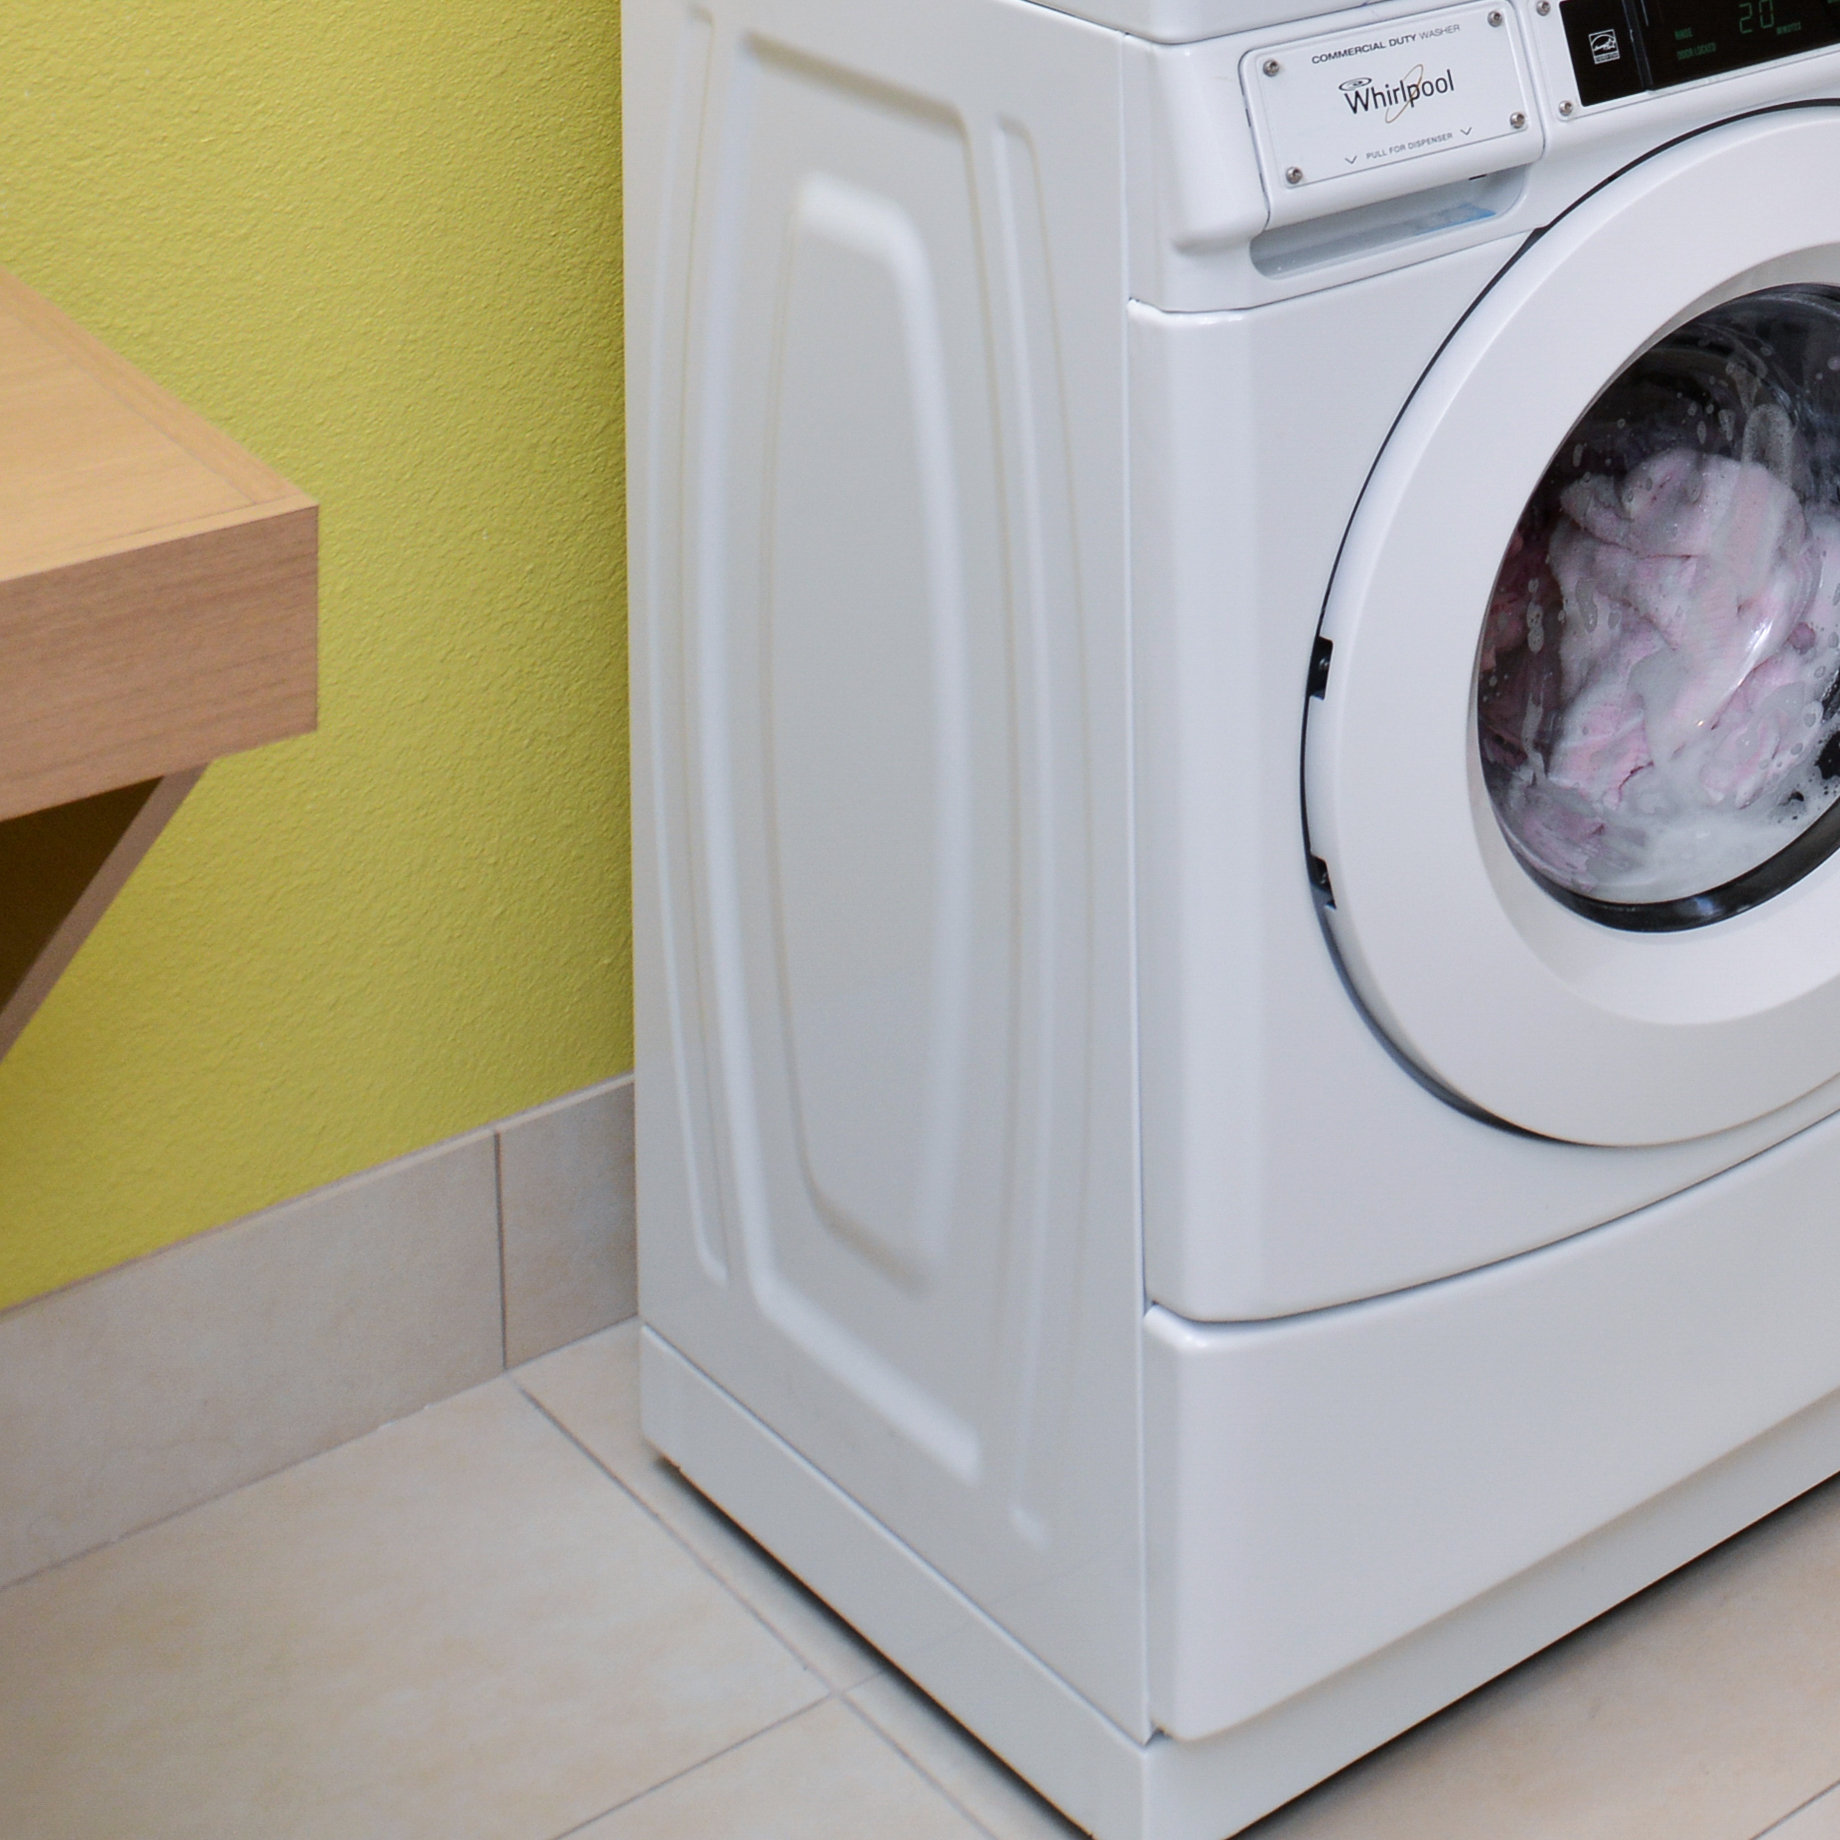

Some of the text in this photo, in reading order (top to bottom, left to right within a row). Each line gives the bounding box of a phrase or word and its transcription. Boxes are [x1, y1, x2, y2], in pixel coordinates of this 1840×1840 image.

[1311, 24, 1461, 65] COMMERCIAL DUTY WASHER
[1344, 68, 1455, 115] Whirlpool
[1365, 132, 1453, 160] PULL FOR DISPENSER
